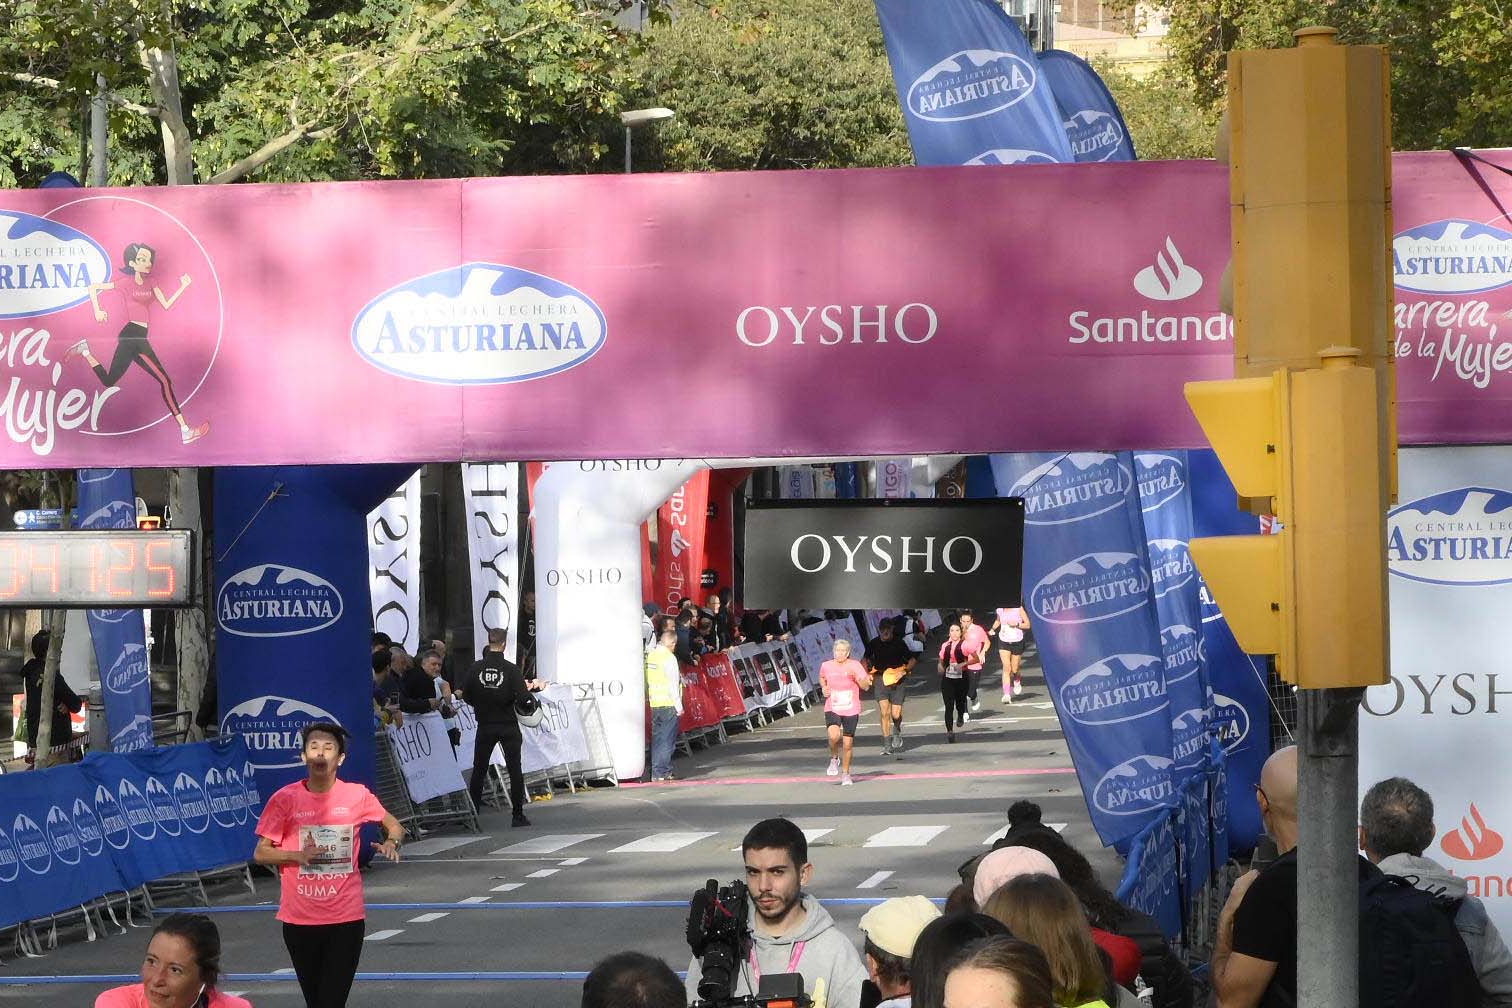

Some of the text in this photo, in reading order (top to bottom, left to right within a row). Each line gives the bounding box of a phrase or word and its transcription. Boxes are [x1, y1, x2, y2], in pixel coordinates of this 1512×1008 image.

[14, 247, 88, 257] LECHERA
[498, 304, 578, 316] LECHERA
[1394, 300, 1489, 329] arrera
[372, 310, 587, 354] ASTURIANA
[736, 302, 938, 347] OYSHO
[1069, 310, 1233, 343] Santand
[1418, 330, 1436, 357] la
[1431, 324, 1512, 389] Muje
[1415, 523, 1482, 532] CENTRAL
[790, 534, 983, 575] OYSHO
[546, 568, 622, 586] OYSHO
[234, 588, 329, 598] CENTRAL LECHERA
[221, 594, 334, 621] ASTURIANA
[486, 673, 498, 682] BP
[236, 721, 277, 729] CENTRAL
[297, 885, 338, 897] SUMA
